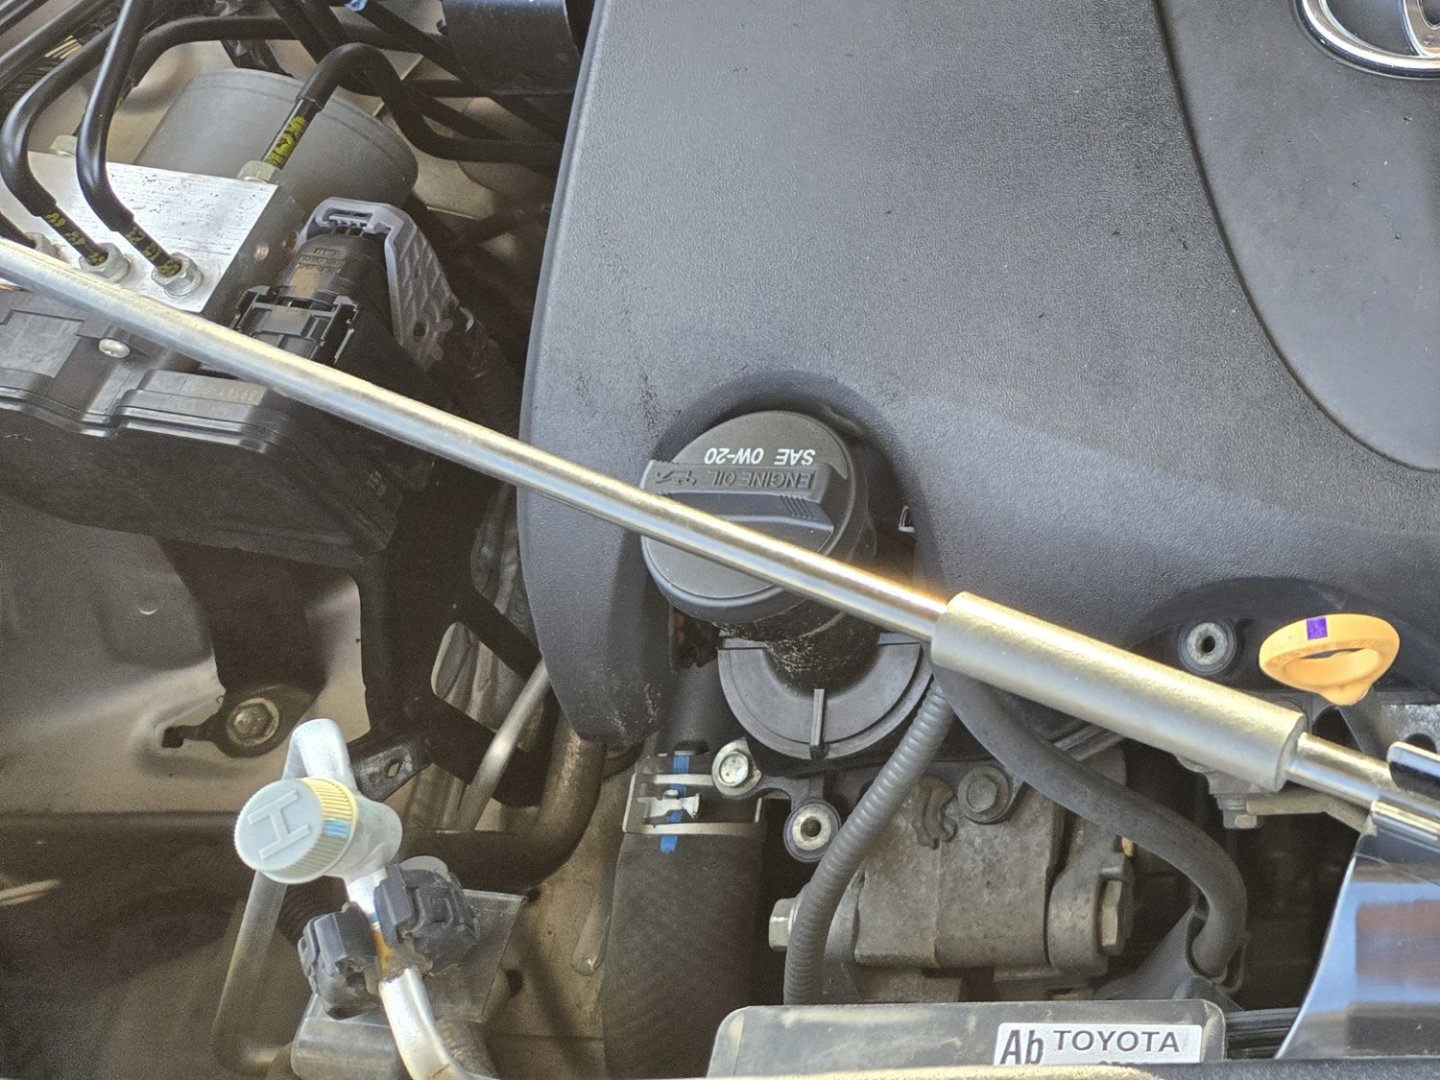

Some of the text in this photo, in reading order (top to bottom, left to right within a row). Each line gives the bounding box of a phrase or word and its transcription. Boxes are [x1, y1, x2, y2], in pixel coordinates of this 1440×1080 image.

[703, 447, 817, 466] SAE 0W-20
[707, 469, 817, 490] ENGINE OIL
[247, 789, 312, 861] H
[1052, 1029, 1181, 1053] TOYOTA
